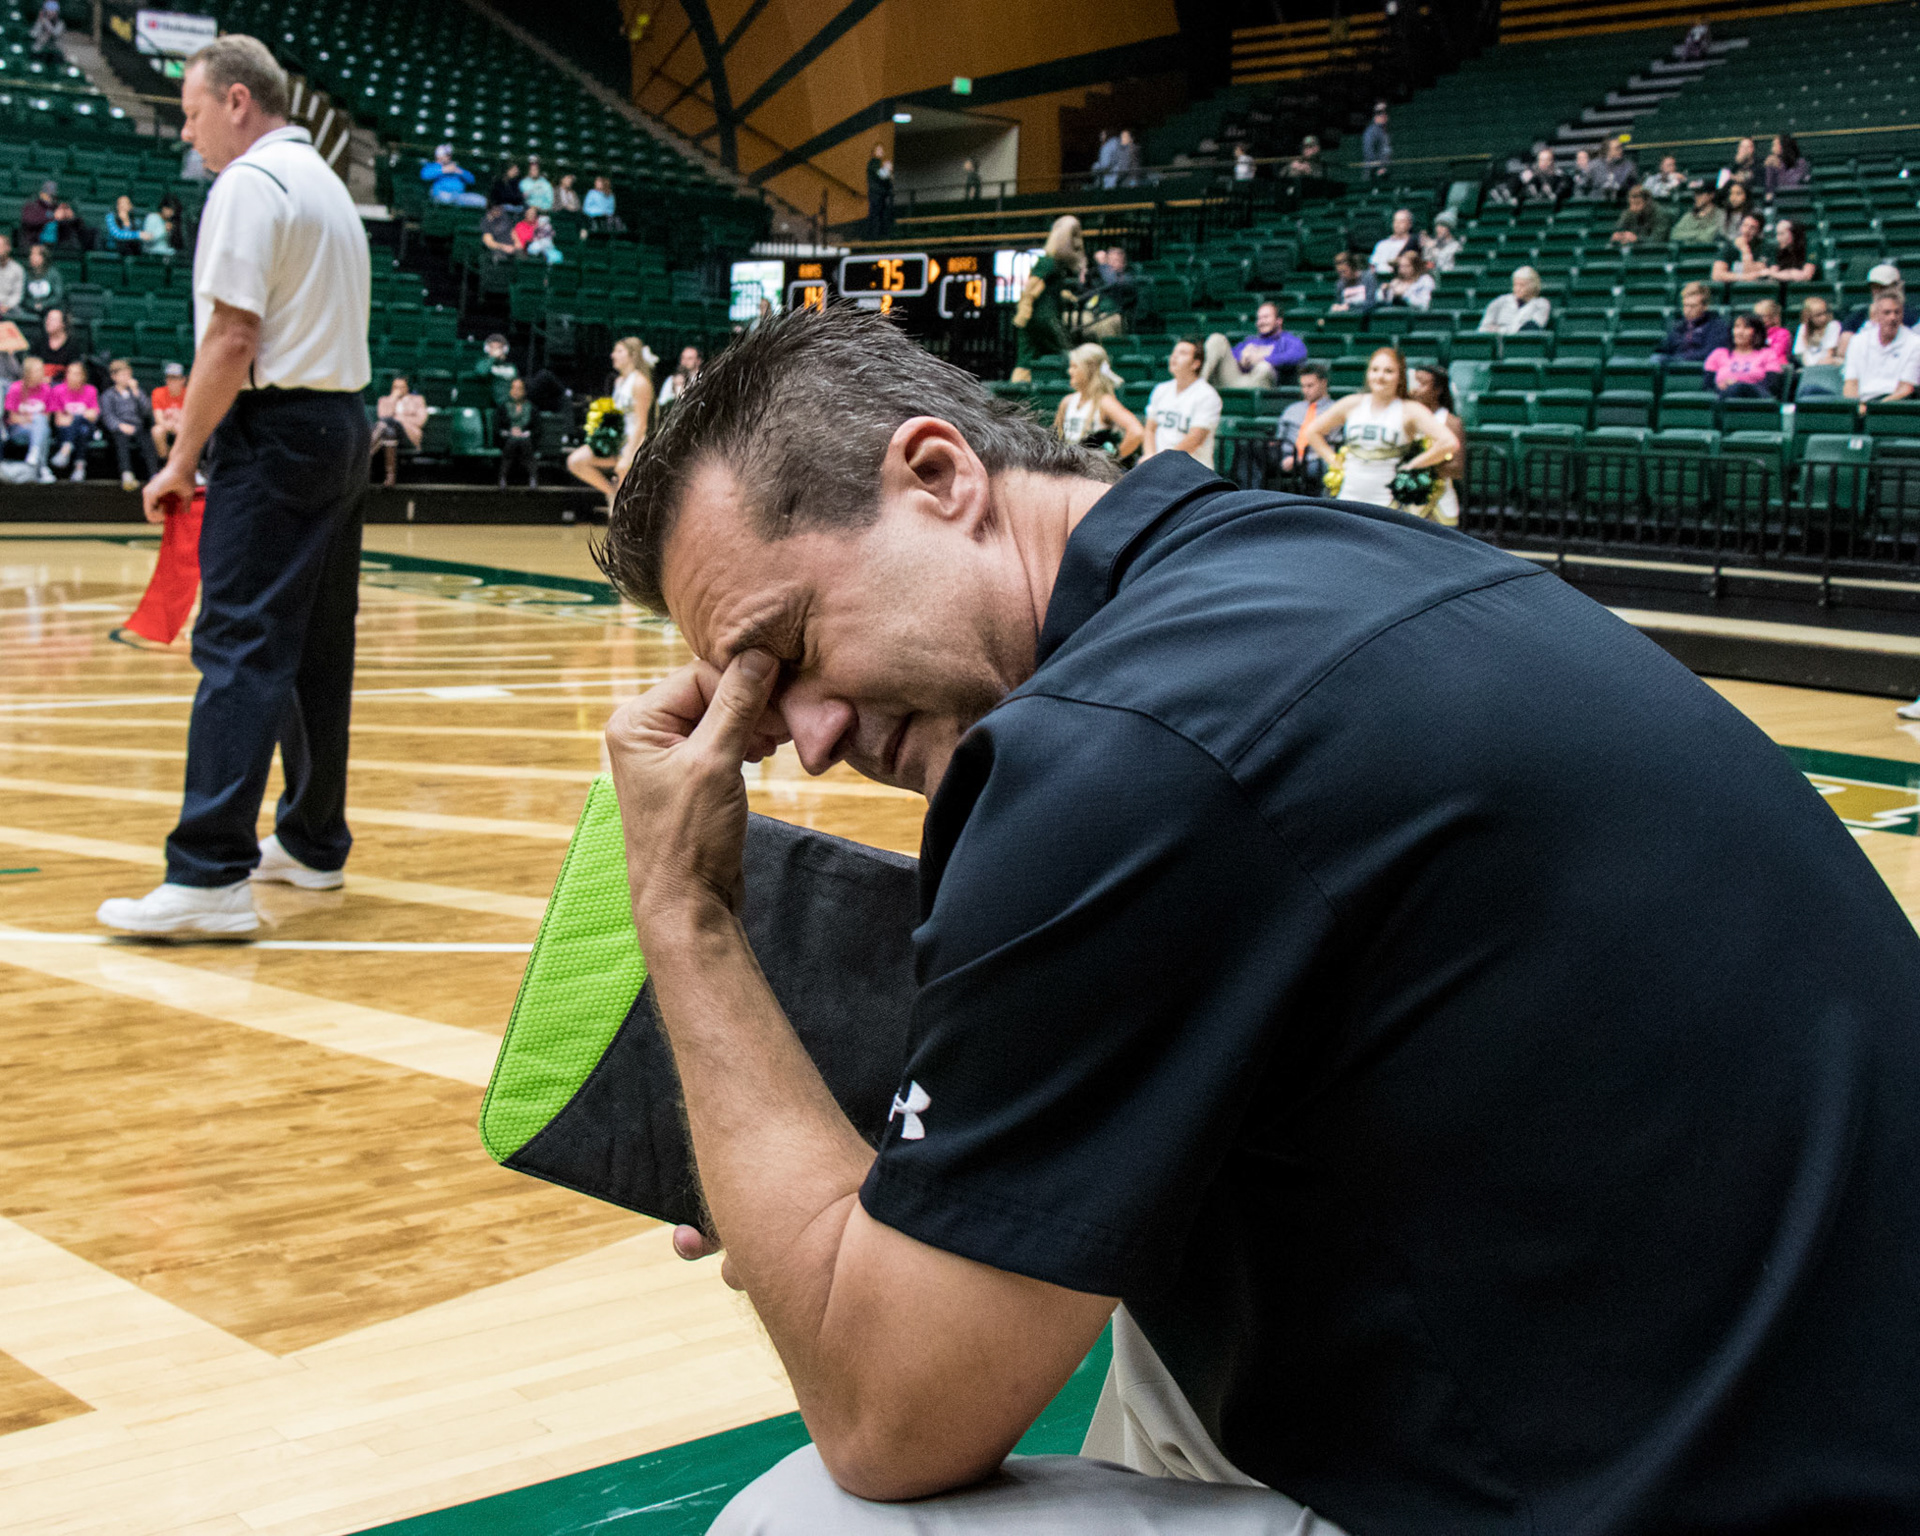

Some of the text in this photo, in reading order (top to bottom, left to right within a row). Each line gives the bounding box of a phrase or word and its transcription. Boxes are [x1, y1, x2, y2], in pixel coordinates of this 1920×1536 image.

[965, 279, 982, 307] 9
[1156, 409, 1192, 434] CSU
[1348, 424, 1399, 446] CSU
